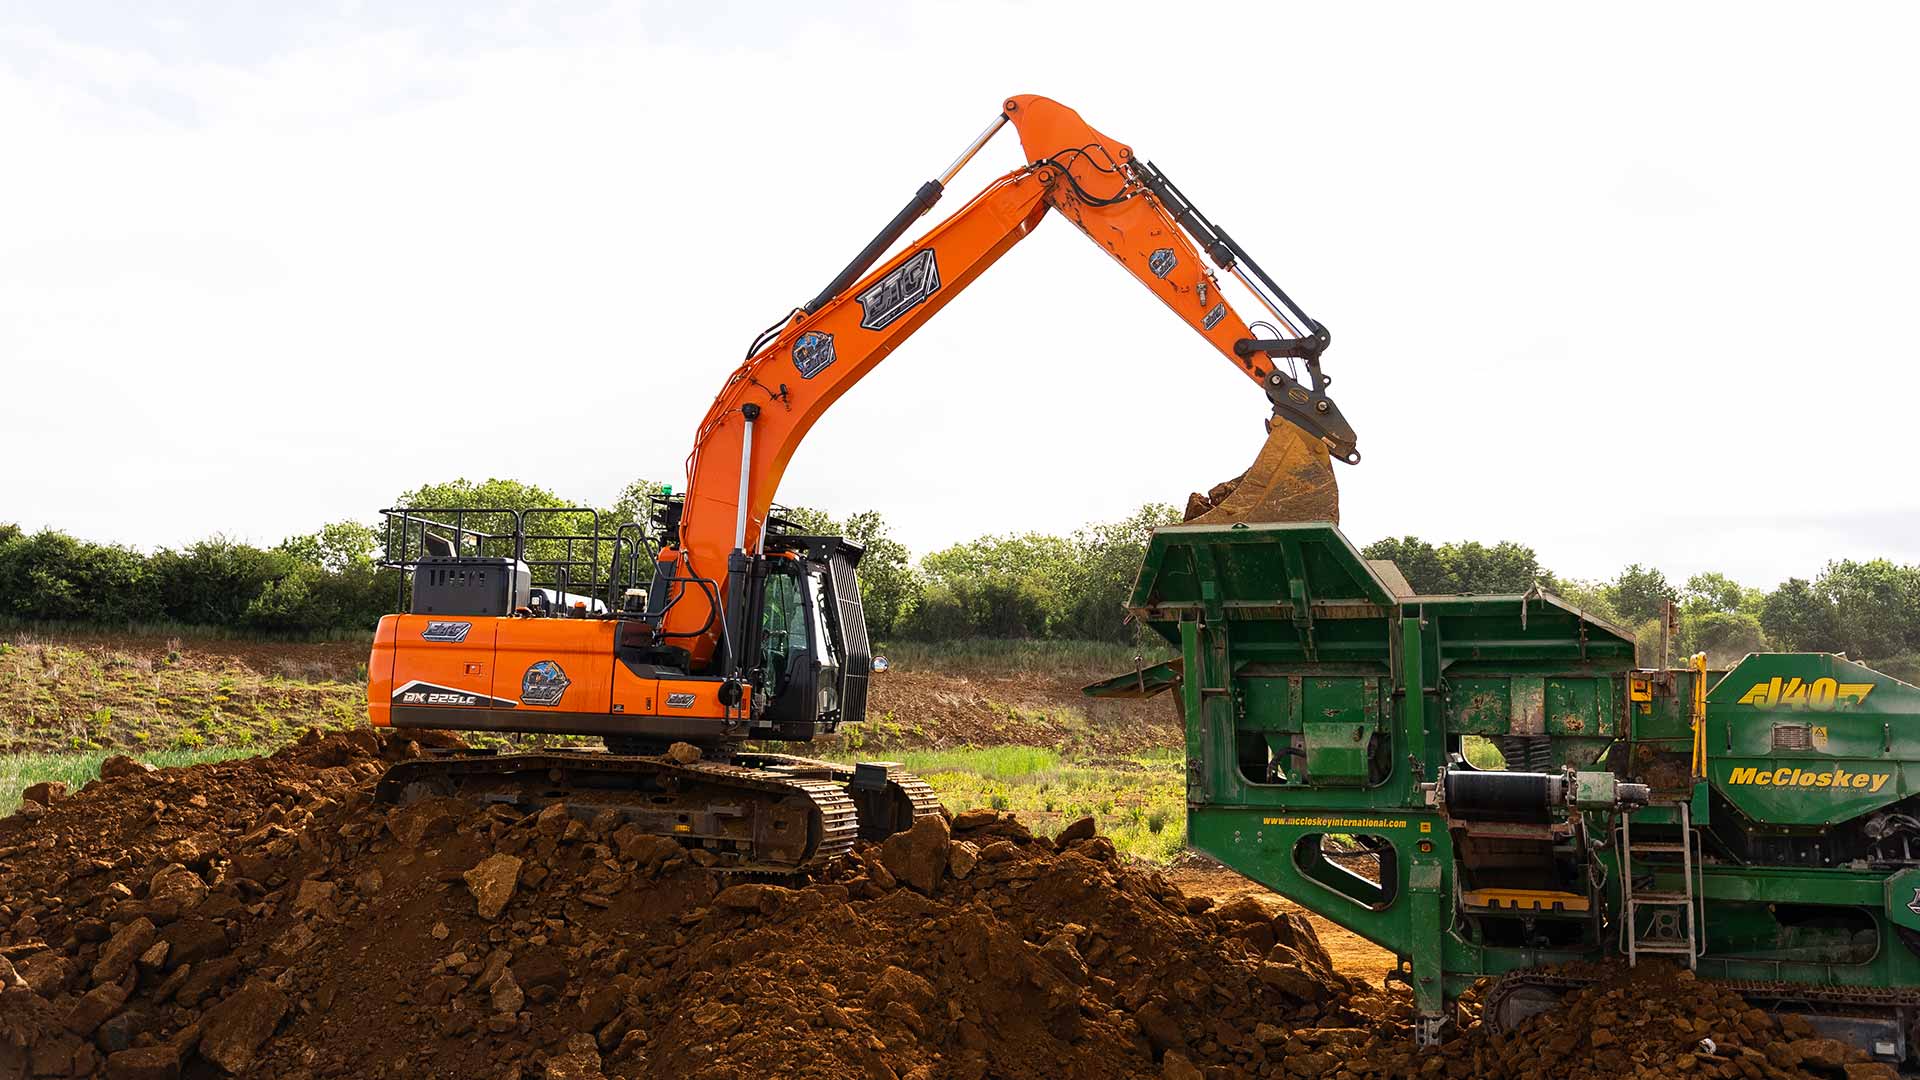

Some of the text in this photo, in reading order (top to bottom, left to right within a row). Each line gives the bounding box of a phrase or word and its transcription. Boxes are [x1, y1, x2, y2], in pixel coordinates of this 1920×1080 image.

[403, 692, 477, 706] DX 225LC
[1753, 677, 1838, 711] J40
[1728, 767, 1890, 793] McCloskey
[1263, 816, 1407, 829] www.mccloskeyinternational.com
